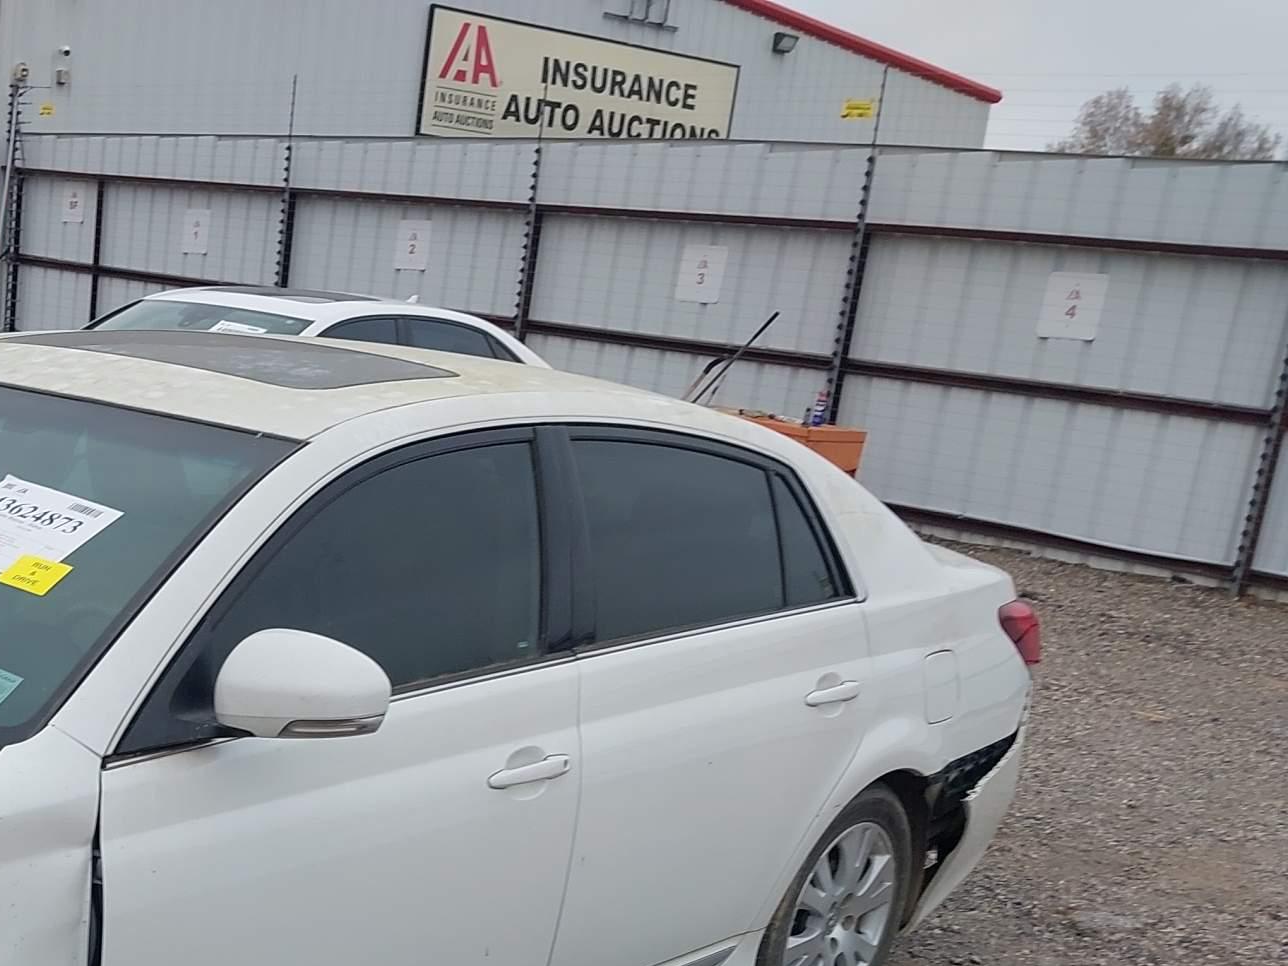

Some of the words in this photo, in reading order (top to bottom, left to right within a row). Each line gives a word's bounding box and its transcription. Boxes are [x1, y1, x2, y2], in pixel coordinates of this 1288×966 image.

[541, 56, 698, 111] INSURANCE
[434, 90, 497, 112] INSURANCE
[500, 94, 580, 131] AUTO
[408, 243, 417, 255] 2
[695, 272, 705, 286] 3
[1064, 304, 1078, 320] 4
